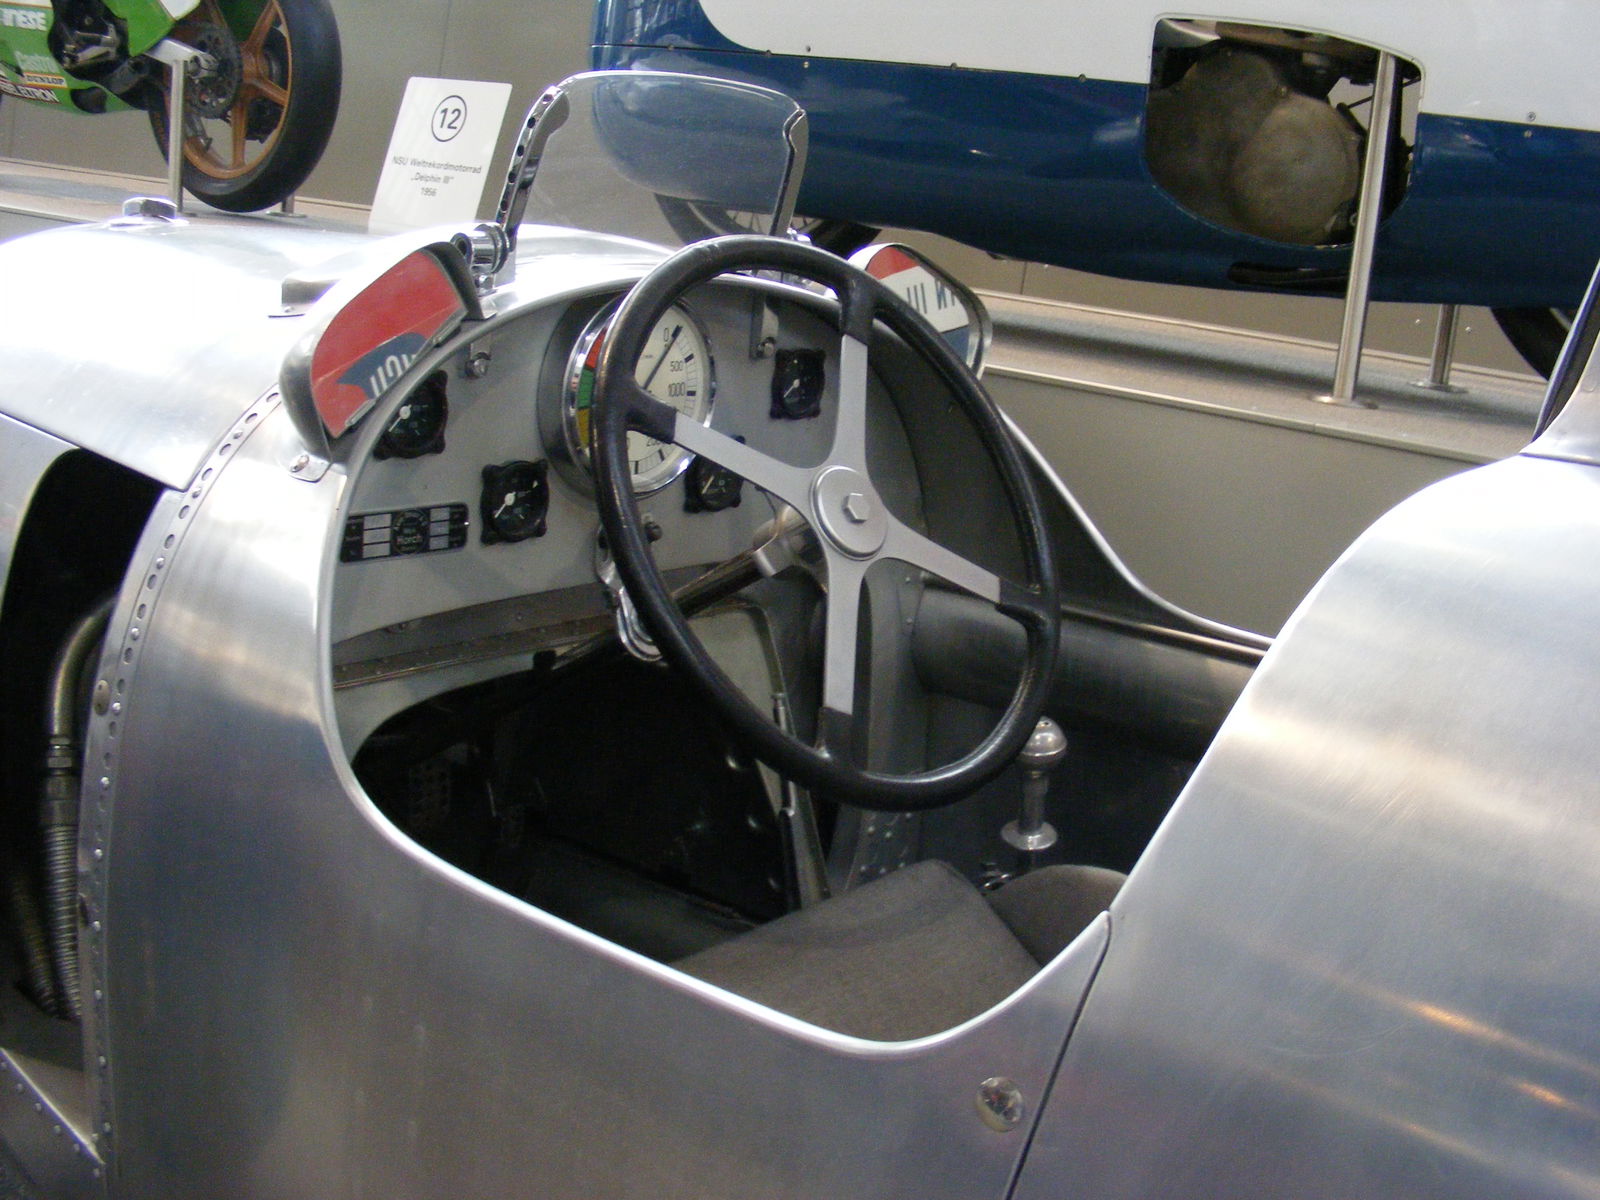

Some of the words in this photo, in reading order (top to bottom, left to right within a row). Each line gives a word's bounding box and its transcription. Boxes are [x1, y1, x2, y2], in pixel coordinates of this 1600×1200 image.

[440, 108, 461, 129] 12
[393, 155, 408, 166] NSU
[663, 327, 670, 342] 0
[670, 361, 684, 373] 500
[668, 382, 686, 398] 1000
